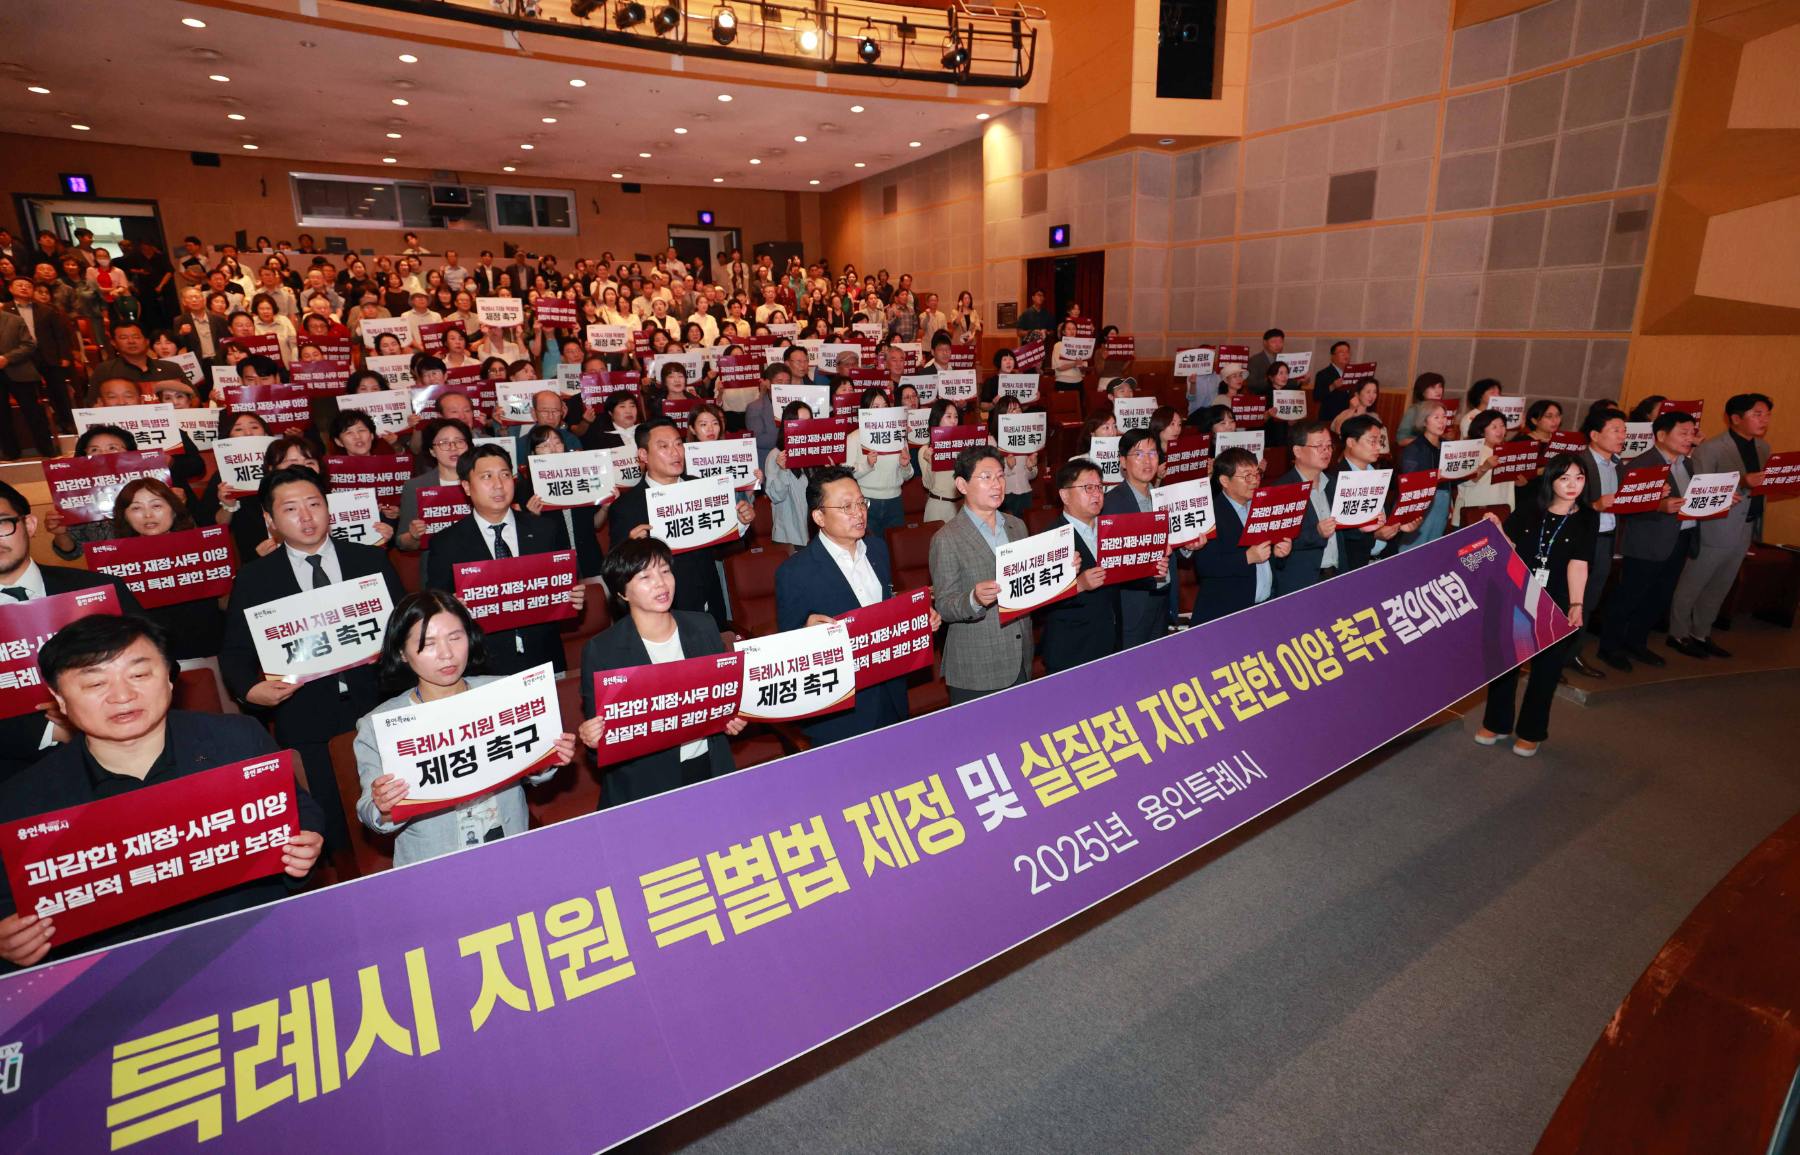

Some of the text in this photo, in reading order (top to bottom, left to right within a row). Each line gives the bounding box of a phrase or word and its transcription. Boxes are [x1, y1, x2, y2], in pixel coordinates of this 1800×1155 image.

[485, 312, 517, 321] 제정 촉구
[594, 339, 623, 347] 제정 촉구
[944, 386, 971, 395] 제정 촉구
[230, 398, 308, 412] 과감한 재정·사무 이양
[369, 402, 406, 413] 지원 특별법
[277, 410, 309, 422] 권한 보장
[381, 412, 404, 425] 촉구
[119, 420, 138, 430] 지원
[140, 418, 170, 428] 특별법
[180, 420, 196, 429] 지원
[864, 420, 897, 430] 특례시 지원
[134, 430, 166, 444] 촉구
[787, 432, 845, 445] 과감한 재정·사무 이양
[870, 432, 891, 445] 제정
[1008, 433, 1042, 446] 제정 촉구
[788, 444, 845, 458] 실질적 권한 보장
[1629, 441, 1648, 452] 촉구
[224, 453, 253, 465] 특례시
[612, 457, 633, 467] 특례시
[692, 453, 753, 467] 특례시 지원 특별법
[1445, 459, 1475, 472] 제정 촉구
[538, 467, 581, 480] 특례시 지원
[620, 466, 642, 480] 제정
[725, 465, 749, 479] 촉구
[1100, 461, 1120, 475] 제정
[54, 477, 92, 492] 과감한
[330, 471, 410, 484] 과감한 재정·사무 이양
[378, 487, 394, 496] 권한
[547, 477, 603, 497] 제정 촉구
[1357, 487, 1369, 496] 지원
[60, 494, 96, 510] 실질적
[656, 494, 730, 519] 특례시 지원 특별법
[1189, 495, 1209, 508] 특별법
[1340, 498, 1379, 515] 제정 촉구
[1688, 495, 1727, 509] 제정 촉구
[338, 508, 371, 523] 특별법
[423, 505, 451, 518] 과감한
[1184, 510, 1207, 528] 촉구
[664, 509, 726, 539] 제정 촉구
[331, 524, 366, 541] 촉구
[1100, 532, 1166, 551] 과감한 재정·사무 이양
[143, 552, 200, 573] 재정·사무
[203, 547, 228, 563] 이양
[1003, 545, 1069, 577] 특례시 지원 특별법
[1100, 551, 1164, 569] 실질적 특례 권한 보장
[148, 575, 175, 590] 특례
[178, 571, 204, 587] 권한
[207, 565, 231, 580] 보장
[1009, 563, 1064, 599] 제정 촉구
[463, 573, 573, 601] 과감한 재정·사무 이양
[467, 591, 572, 619] 실질적 특례 권한 보장
[264, 598, 383, 641] 특례시 지원 특별법
[849, 613, 929, 651] 감한 재정·사무 이양
[281, 618, 381, 665] 제정 촉구
[852, 634, 930, 672] 질적 특례 권한 보장
[749, 647, 845, 683] 특례시 지원 특별법
[757, 668, 839, 707] 제정 촉구
[603, 680, 739, 721] 과감한 재정·사무 이양
[396, 696, 546, 759] 특례시 지원 특별법
[605, 702, 736, 745] 실질적 특례 권한 보장
[415, 723, 540, 787] 제정 촉구
[243, 769, 256, 780] 용인
[17, 820, 69, 840] 용인특례시
[1014, 751, 1268, 895] 2025년 용인특례시
[24, 792, 287, 886] 과감한 재정·사무 이양
[107, 946, 441, 1151] 특례시
[458, 886, 637, 1032] 지원
[639, 815, 851, 948] 특별법
[842, 773, 966, 877] 제정
[956, 752, 1027, 832] 및
[1019, 705, 1153, 808] 실질적
[1137, 651, 1290, 753] 지위·권한
[1277, 627, 1343, 691] 이양
[1331, 607, 1389, 663] 촉구
[1382, 571, 1478, 645] 결의대회
[35, 825, 291, 919] 실질적 특례 권한 보장
